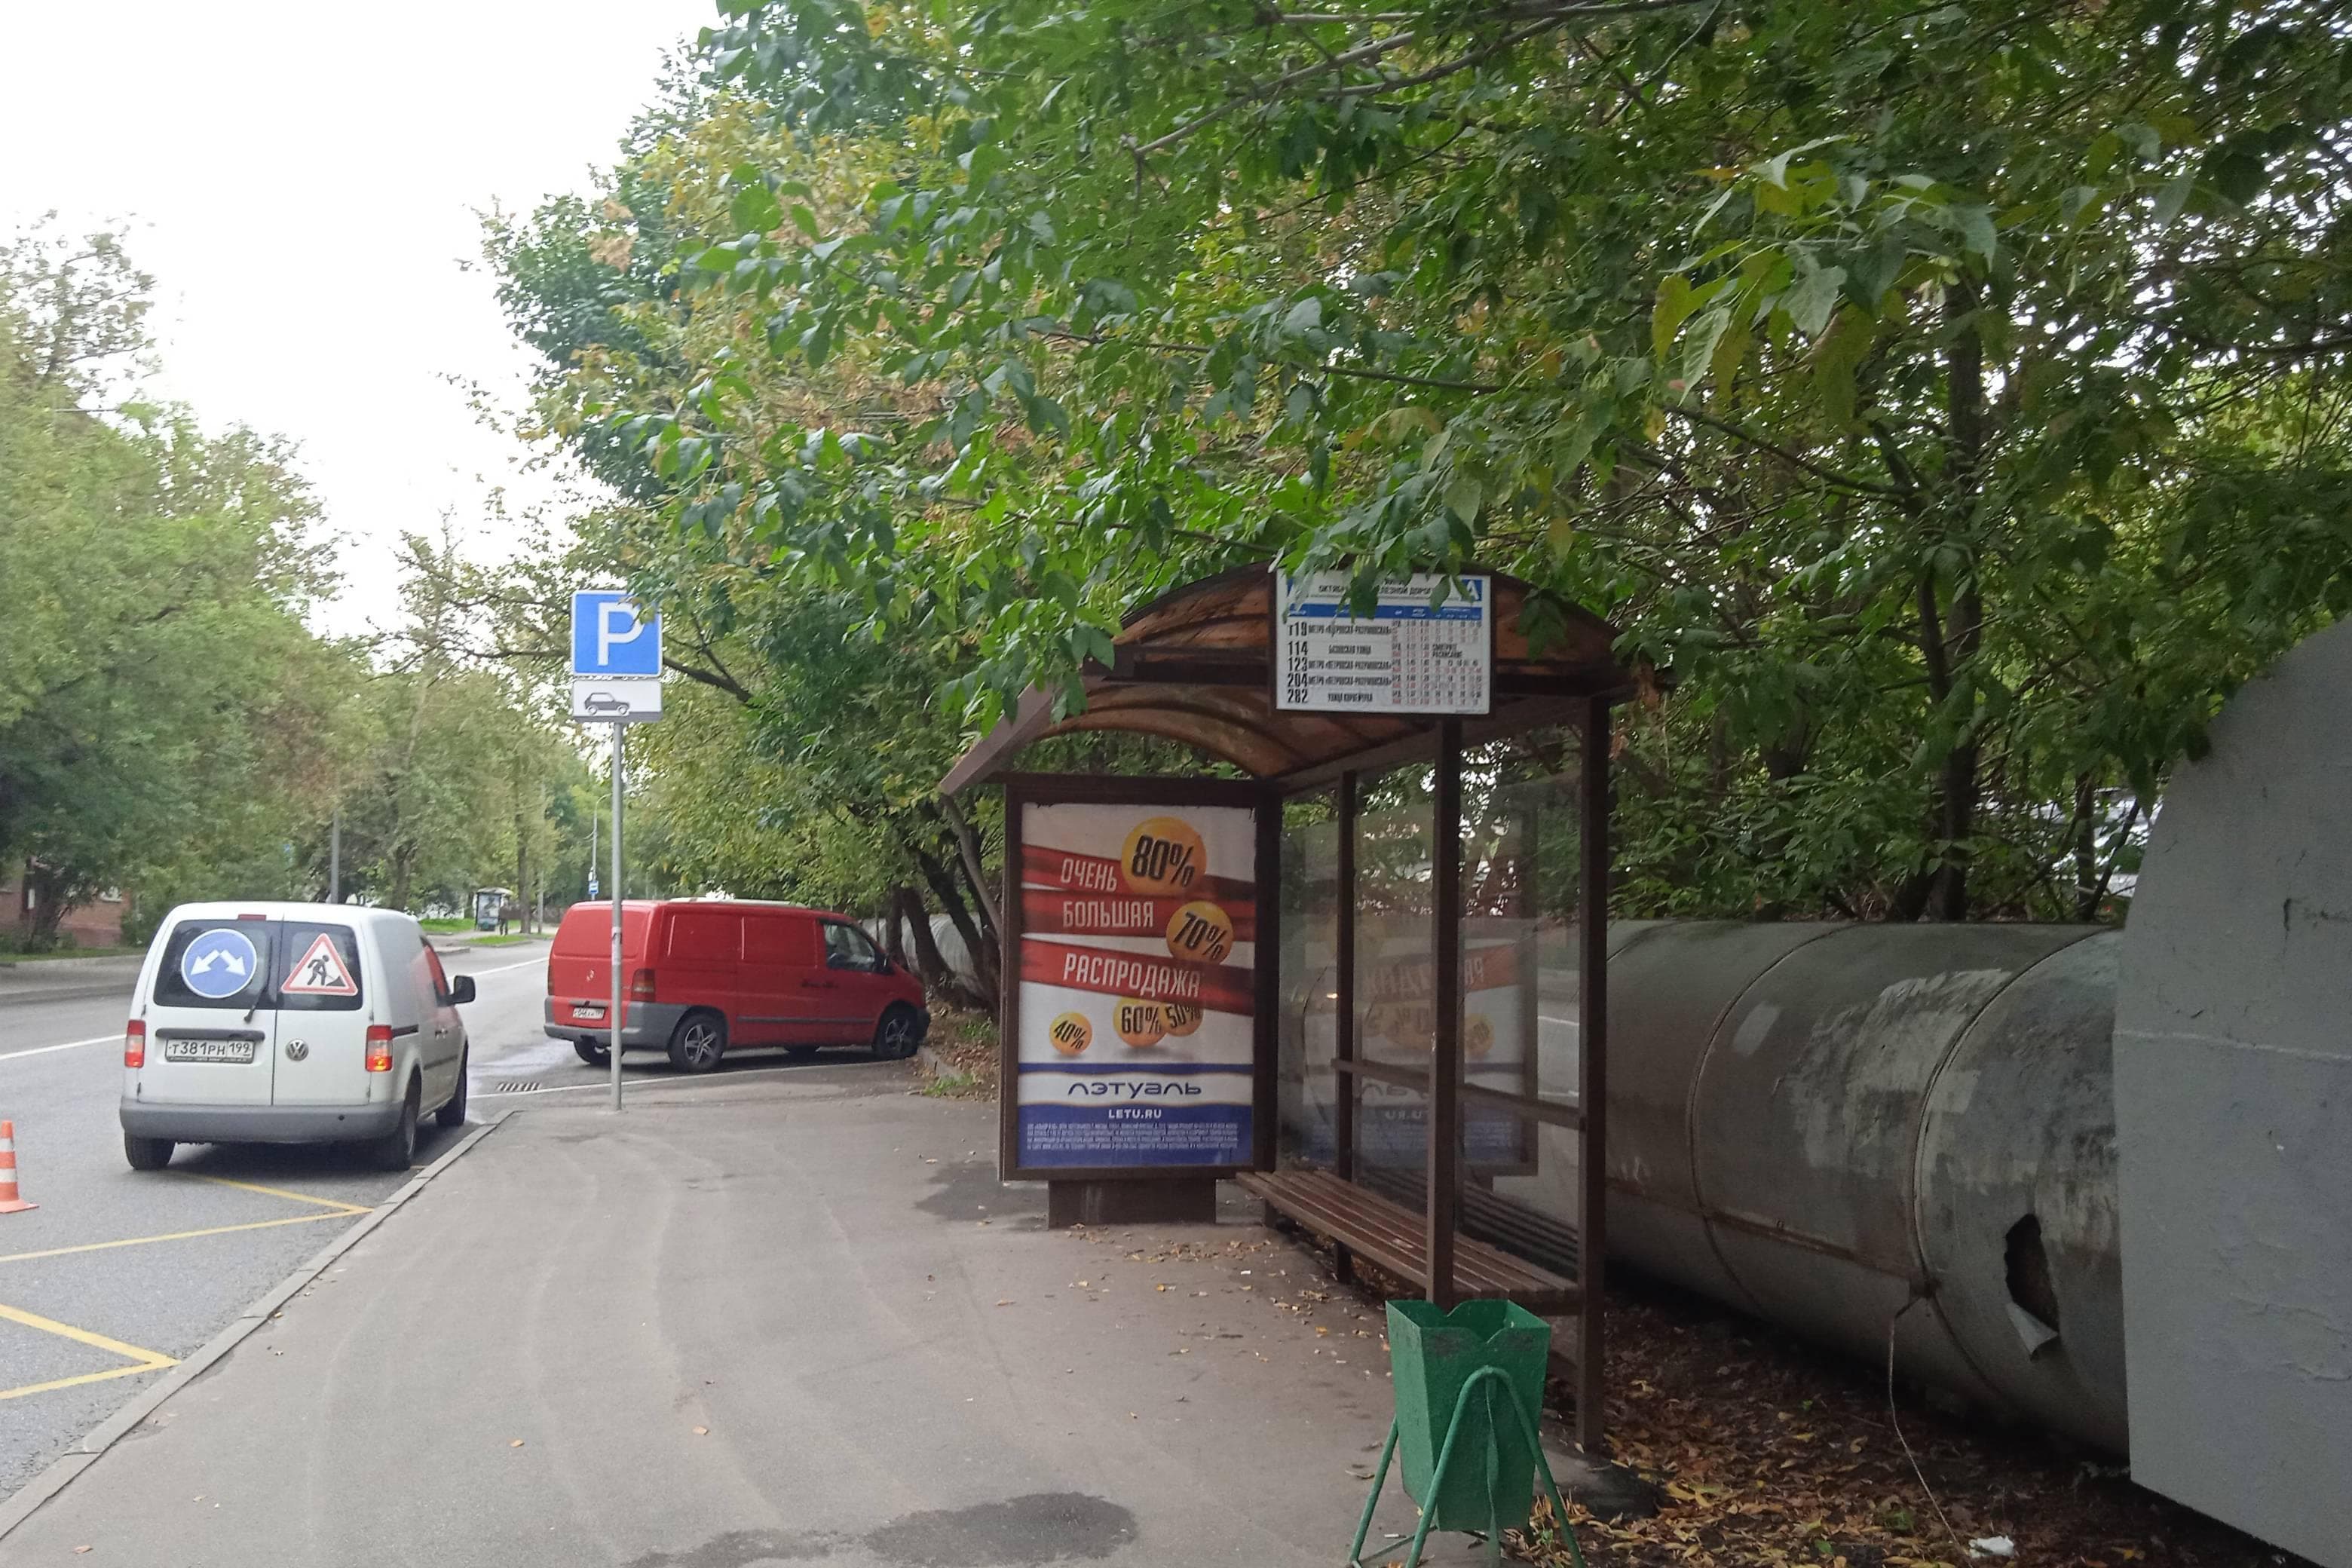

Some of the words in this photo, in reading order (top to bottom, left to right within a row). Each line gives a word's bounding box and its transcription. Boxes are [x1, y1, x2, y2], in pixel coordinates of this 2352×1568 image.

[597, 602, 646, 666] P
[1288, 641, 1308, 656] 114
[1288, 657, 1308, 672] 123
[1288, 672, 1308, 688] 204
[1288, 688, 1308, 703] 282
[1061, 858, 1118, 893] ОЧЕНЬ
[1131, 835, 1196, 888] 80%
[1062, 900, 1154, 929] БОЛЬШАЯ
[1172, 911, 1228, 960] 70%
[1062, 952, 1202, 998] РАСПРОДАЖА
[1121, 1006, 1162, 1035] 60%
[1165, 1003, 1201, 1029] 50%
[228, 1043, 250, 1054] 199
[1053, 1019, 1086, 1049] 40%
[1108, 1108, 1162, 1119] LETU.RU
